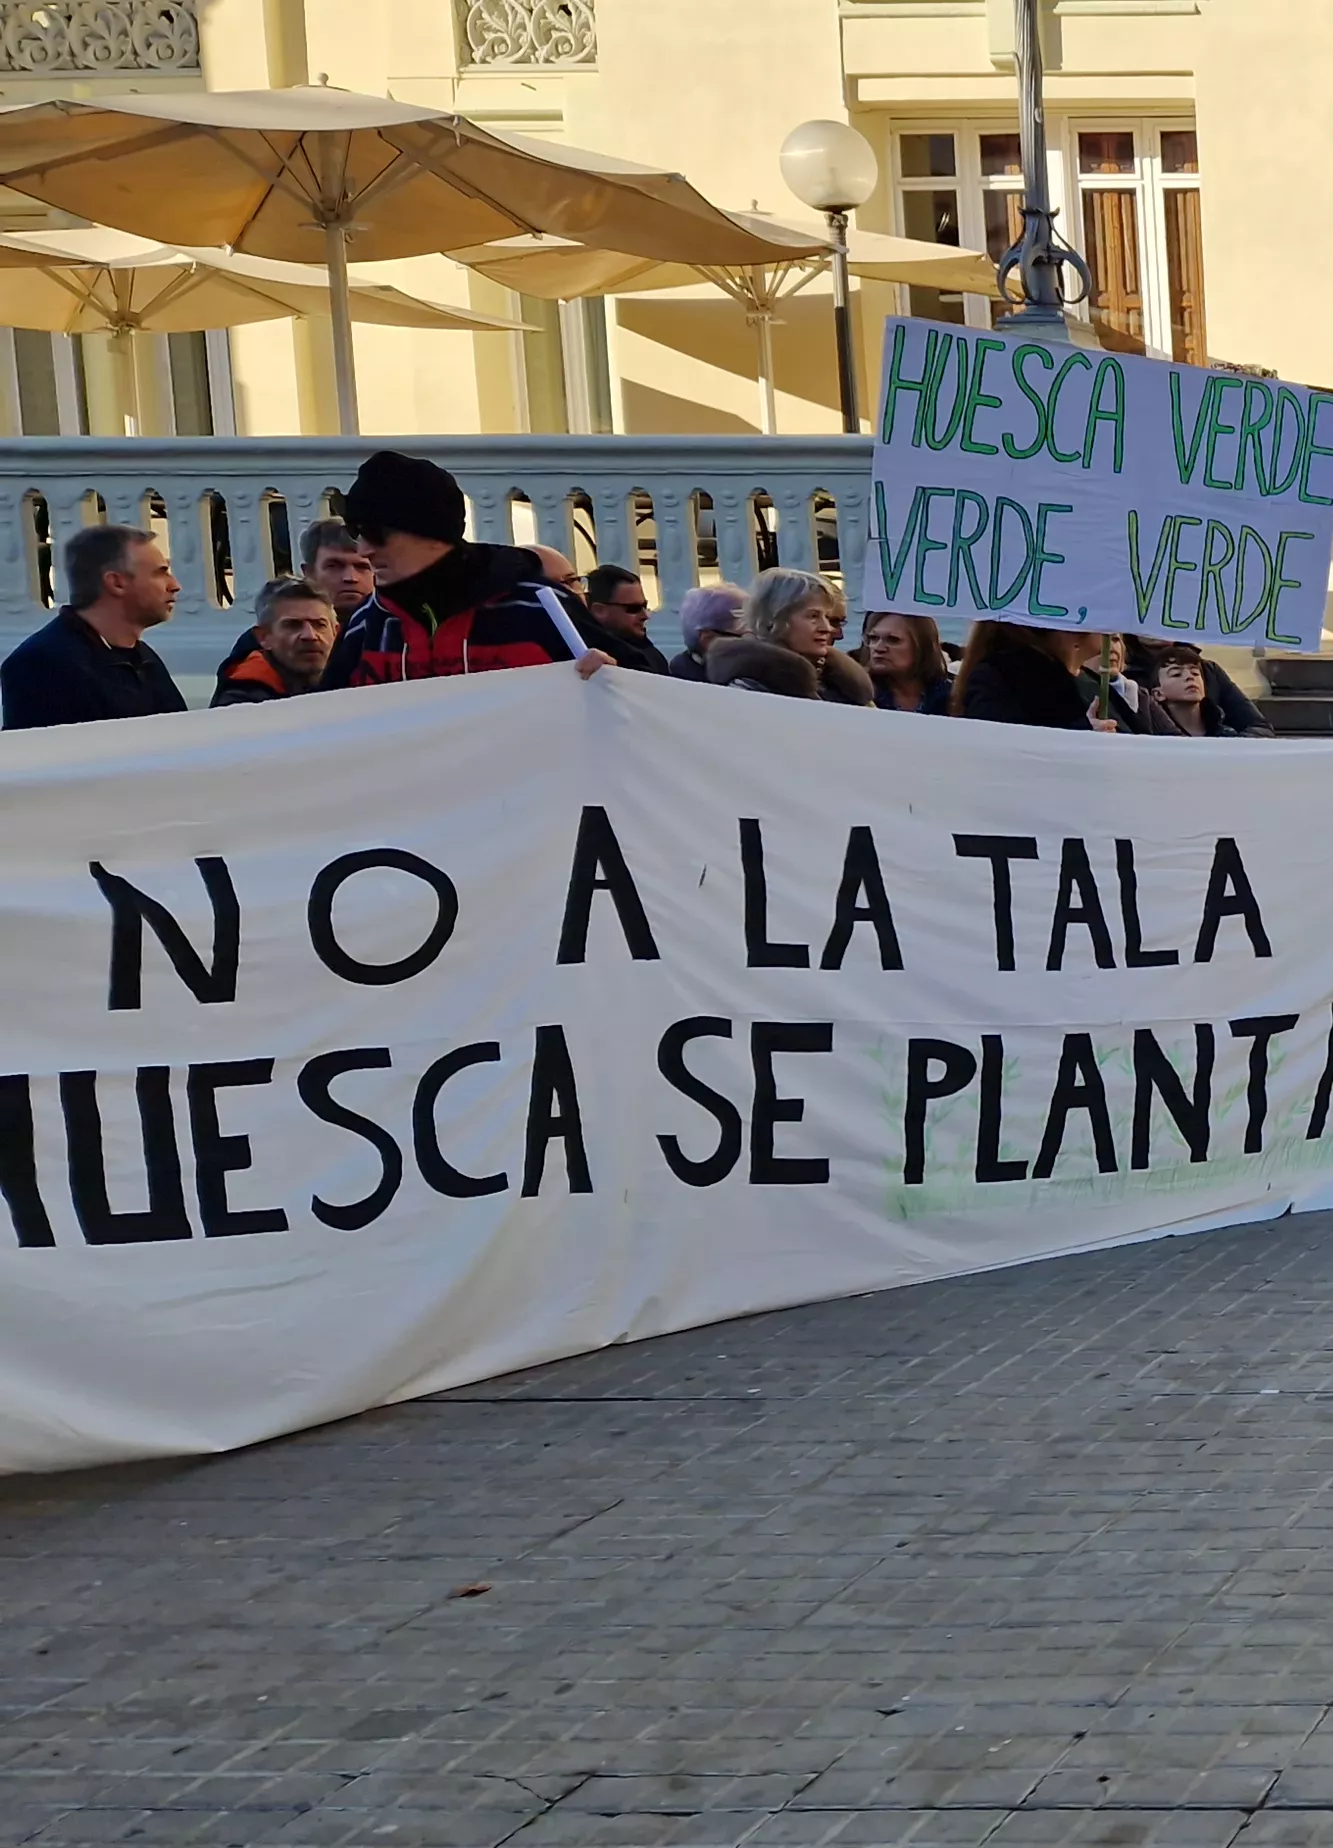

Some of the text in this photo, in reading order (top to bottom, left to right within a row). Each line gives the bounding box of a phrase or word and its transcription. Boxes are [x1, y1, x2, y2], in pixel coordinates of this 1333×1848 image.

[883, 324, 1126, 474] HUESCA
[875, 480, 1315, 644] VERDE, VERDE
[90, 806, 1273, 1010] NO A LA TALA
[656, 1016, 834, 1188] SE
